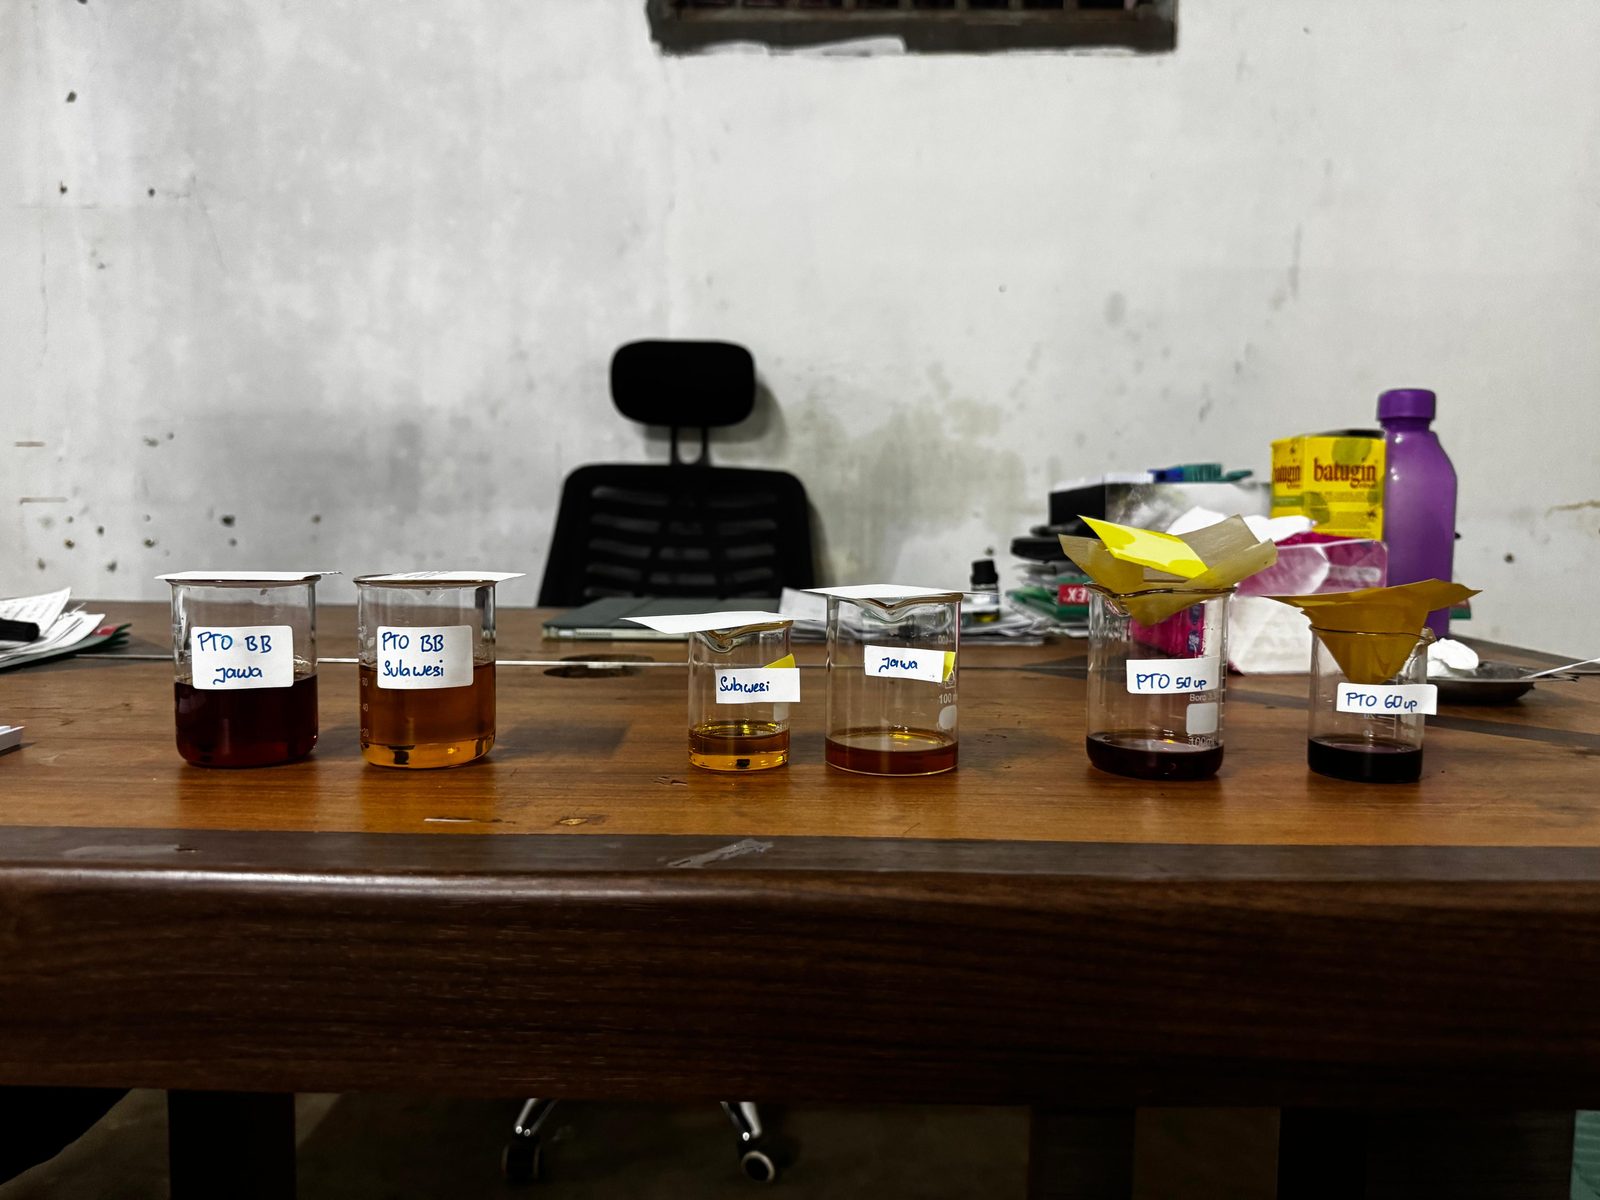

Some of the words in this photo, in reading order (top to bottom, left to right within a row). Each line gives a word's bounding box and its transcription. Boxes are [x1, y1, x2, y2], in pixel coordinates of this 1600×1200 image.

[1313, 457, 1377, 489] batugin
[197, 631, 234, 652] PTO
[245, 635, 272, 653] BB
[382, 631, 410, 651] PTO
[420, 634, 444, 653] BB
[1136, 672, 1170, 690] PTO
[1175, 676, 1192, 689] 50
[1194, 679, 1207, 691] up
[1345, 692, 1377, 707] PTO
[1384, 694, 1403, 709] 60
[1404, 700, 1418, 713] up
